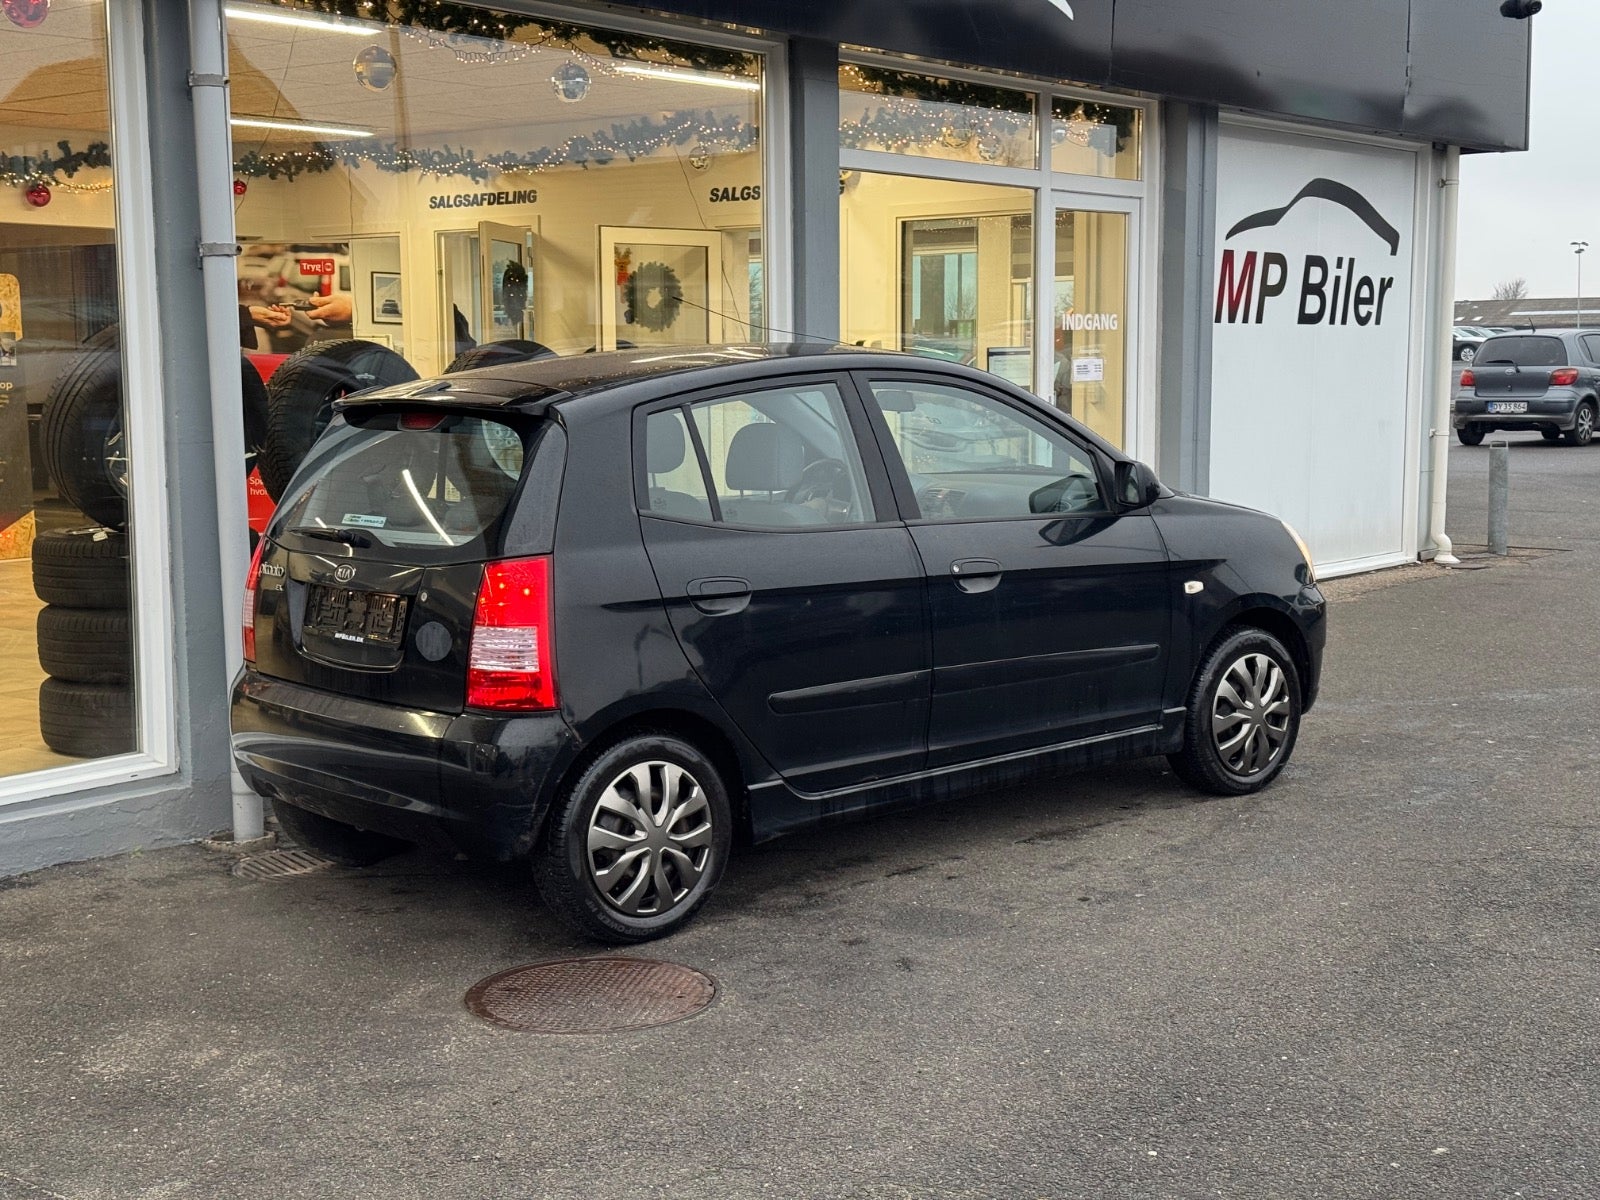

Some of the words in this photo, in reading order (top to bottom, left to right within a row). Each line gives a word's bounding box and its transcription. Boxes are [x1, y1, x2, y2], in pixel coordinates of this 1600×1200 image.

[429, 189, 537, 209] SALGSAFDELING
[301, 262, 321, 273] Tryg
[1214, 249, 1288, 324] MP
[1297, 254, 1394, 326] Biler
[1062, 313, 1118, 331] INDGANG
[336, 567, 351, 579] KIA
